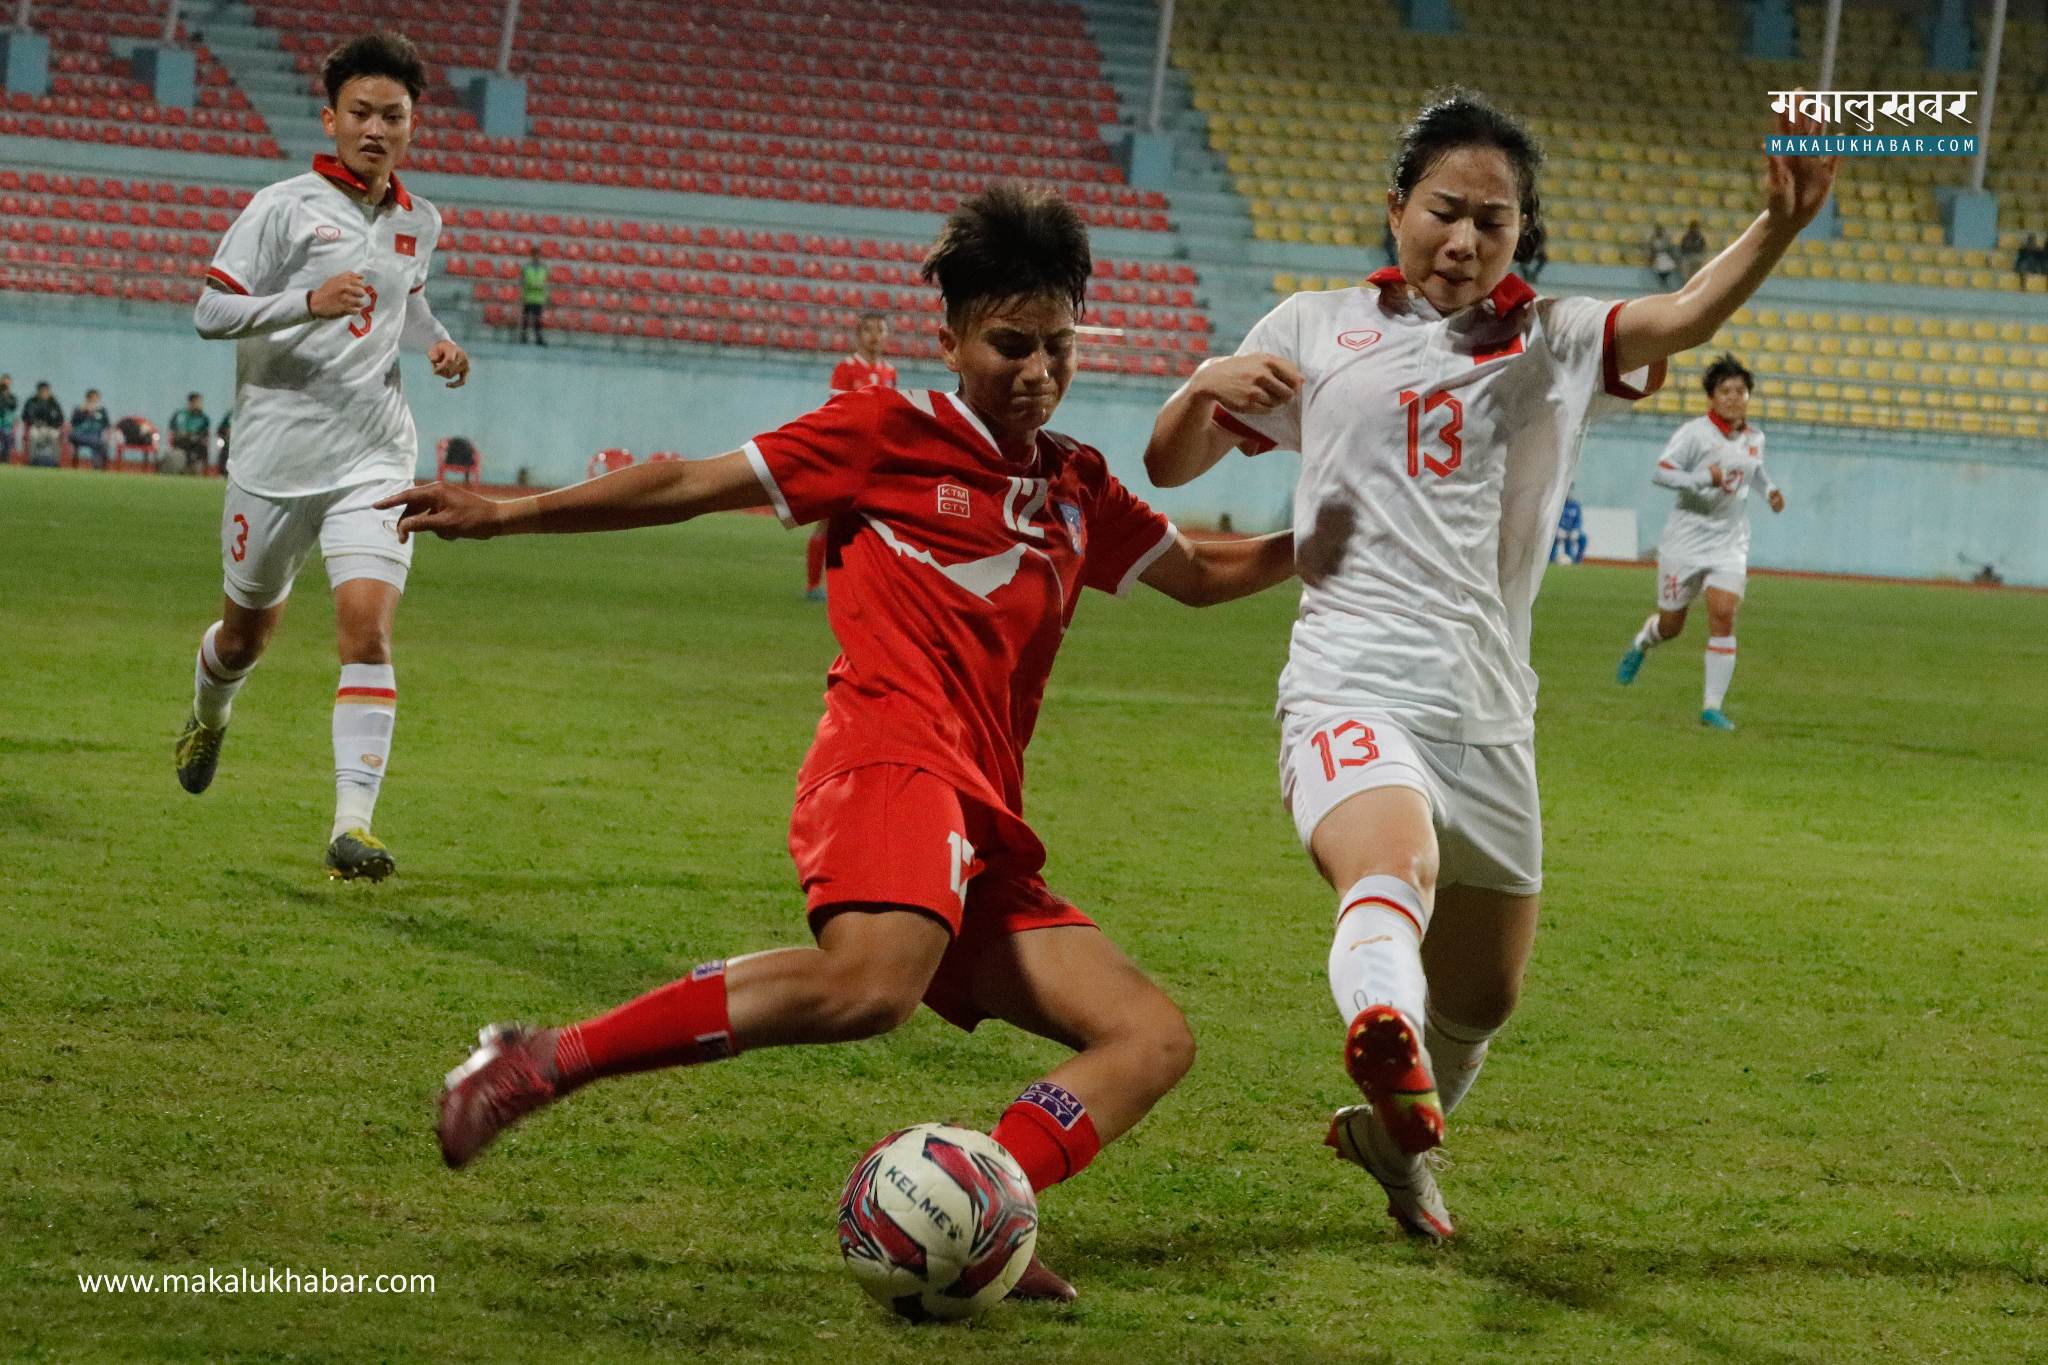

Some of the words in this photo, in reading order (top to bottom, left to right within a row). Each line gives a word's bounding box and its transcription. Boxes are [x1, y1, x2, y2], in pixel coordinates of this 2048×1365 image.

[348, 285, 377, 338] 3
[1399, 389, 1464, 479] 13
[941, 487, 966, 499] KTM
[942, 502, 966, 513] CTY
[1003, 476, 1047, 539] 12
[231, 513, 249, 562] 3
[1311, 719, 1380, 782] 13
[1020, 1092, 1070, 1117] CTY
[885, 1164, 953, 1231] KELME
